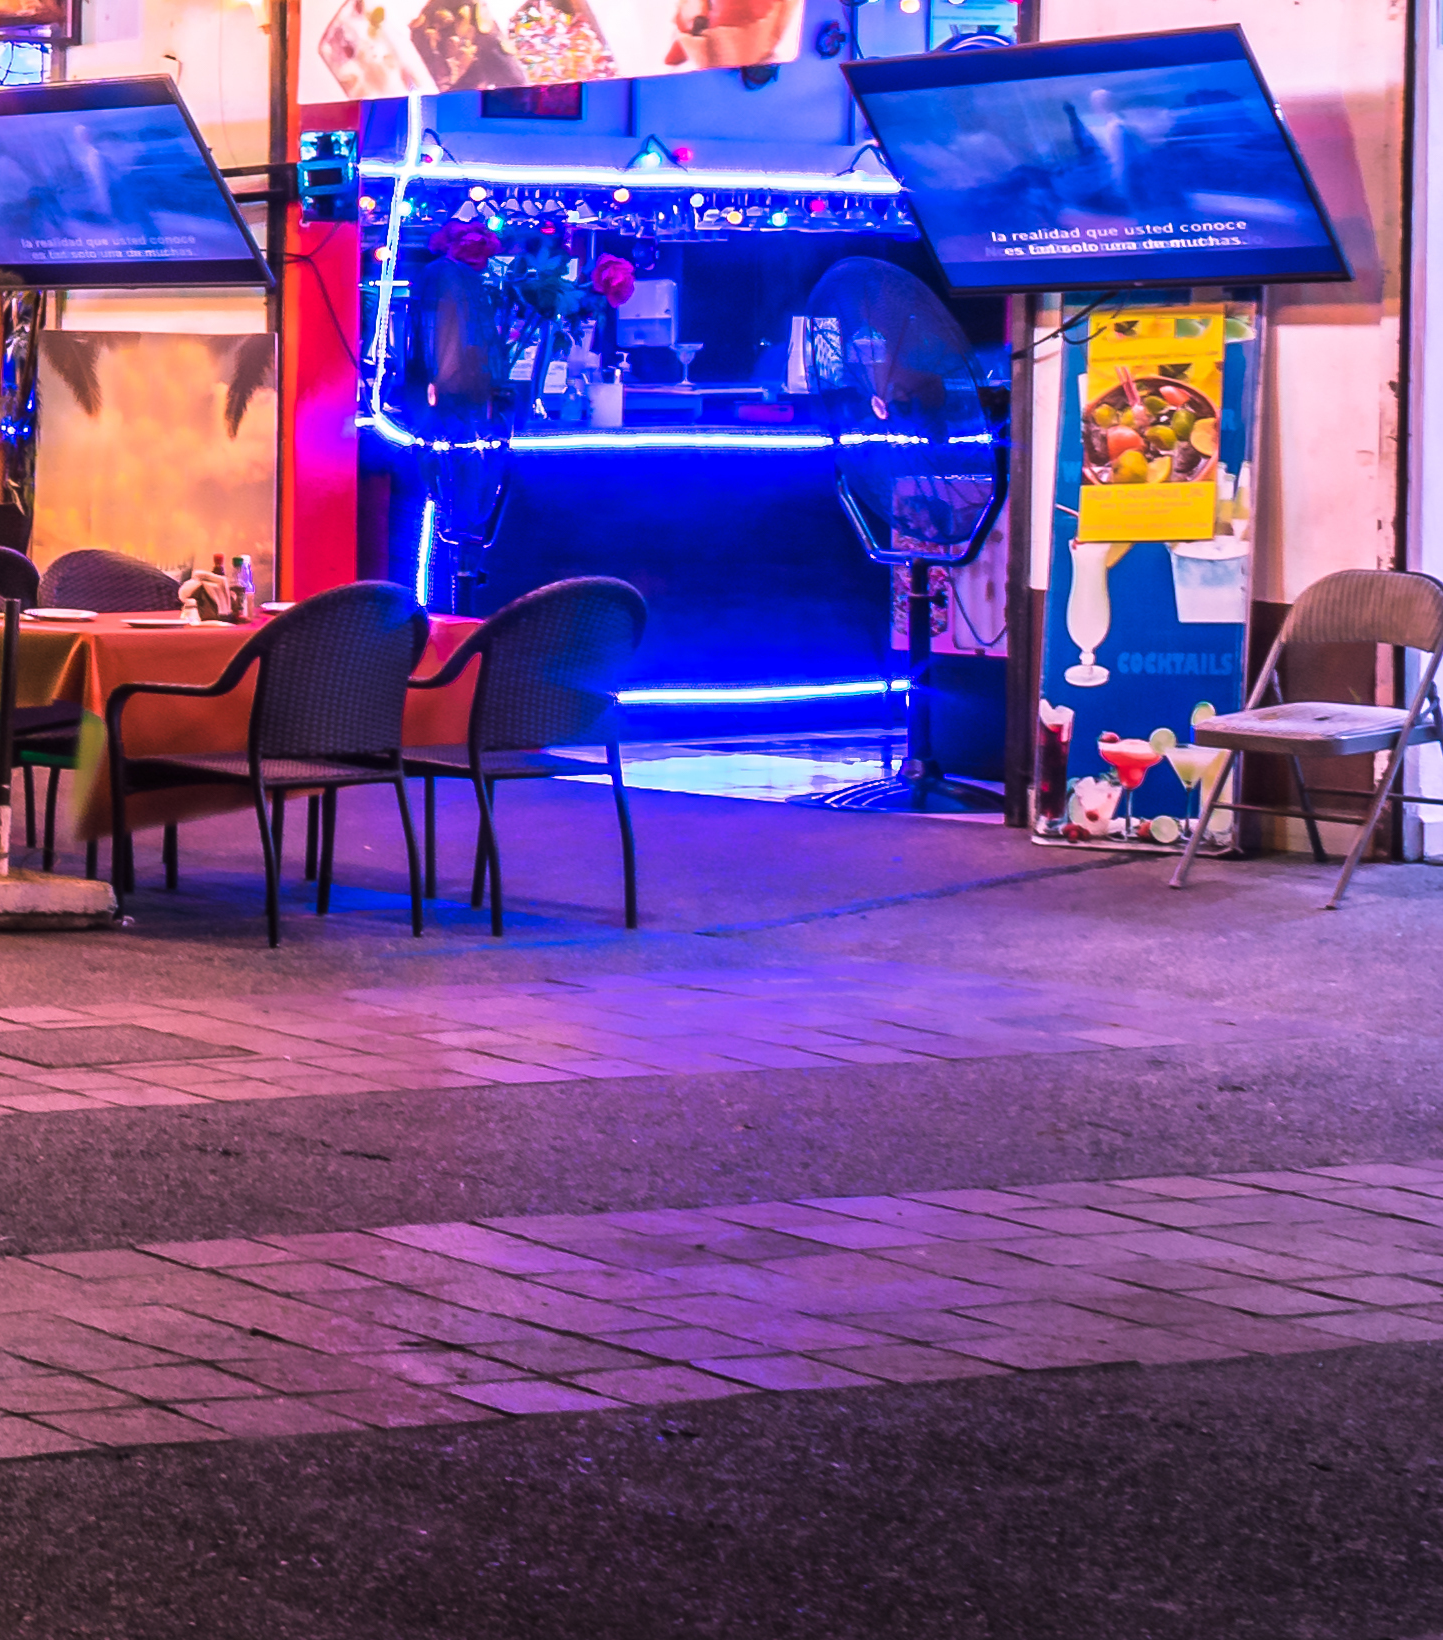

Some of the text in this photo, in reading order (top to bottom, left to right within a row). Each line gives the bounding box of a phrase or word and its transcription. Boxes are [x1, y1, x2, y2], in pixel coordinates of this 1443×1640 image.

[991, 221, 1247, 243] la realidad que usted conoce
[35, 237, 83, 248] realidad
[85, 238, 110, 248] que
[112, 235, 147, 246] usted
[149, 235, 196, 245] conoce
[1004, 246, 1025, 256] es
[1116, 651, 1234, 676] COCKTAILS
